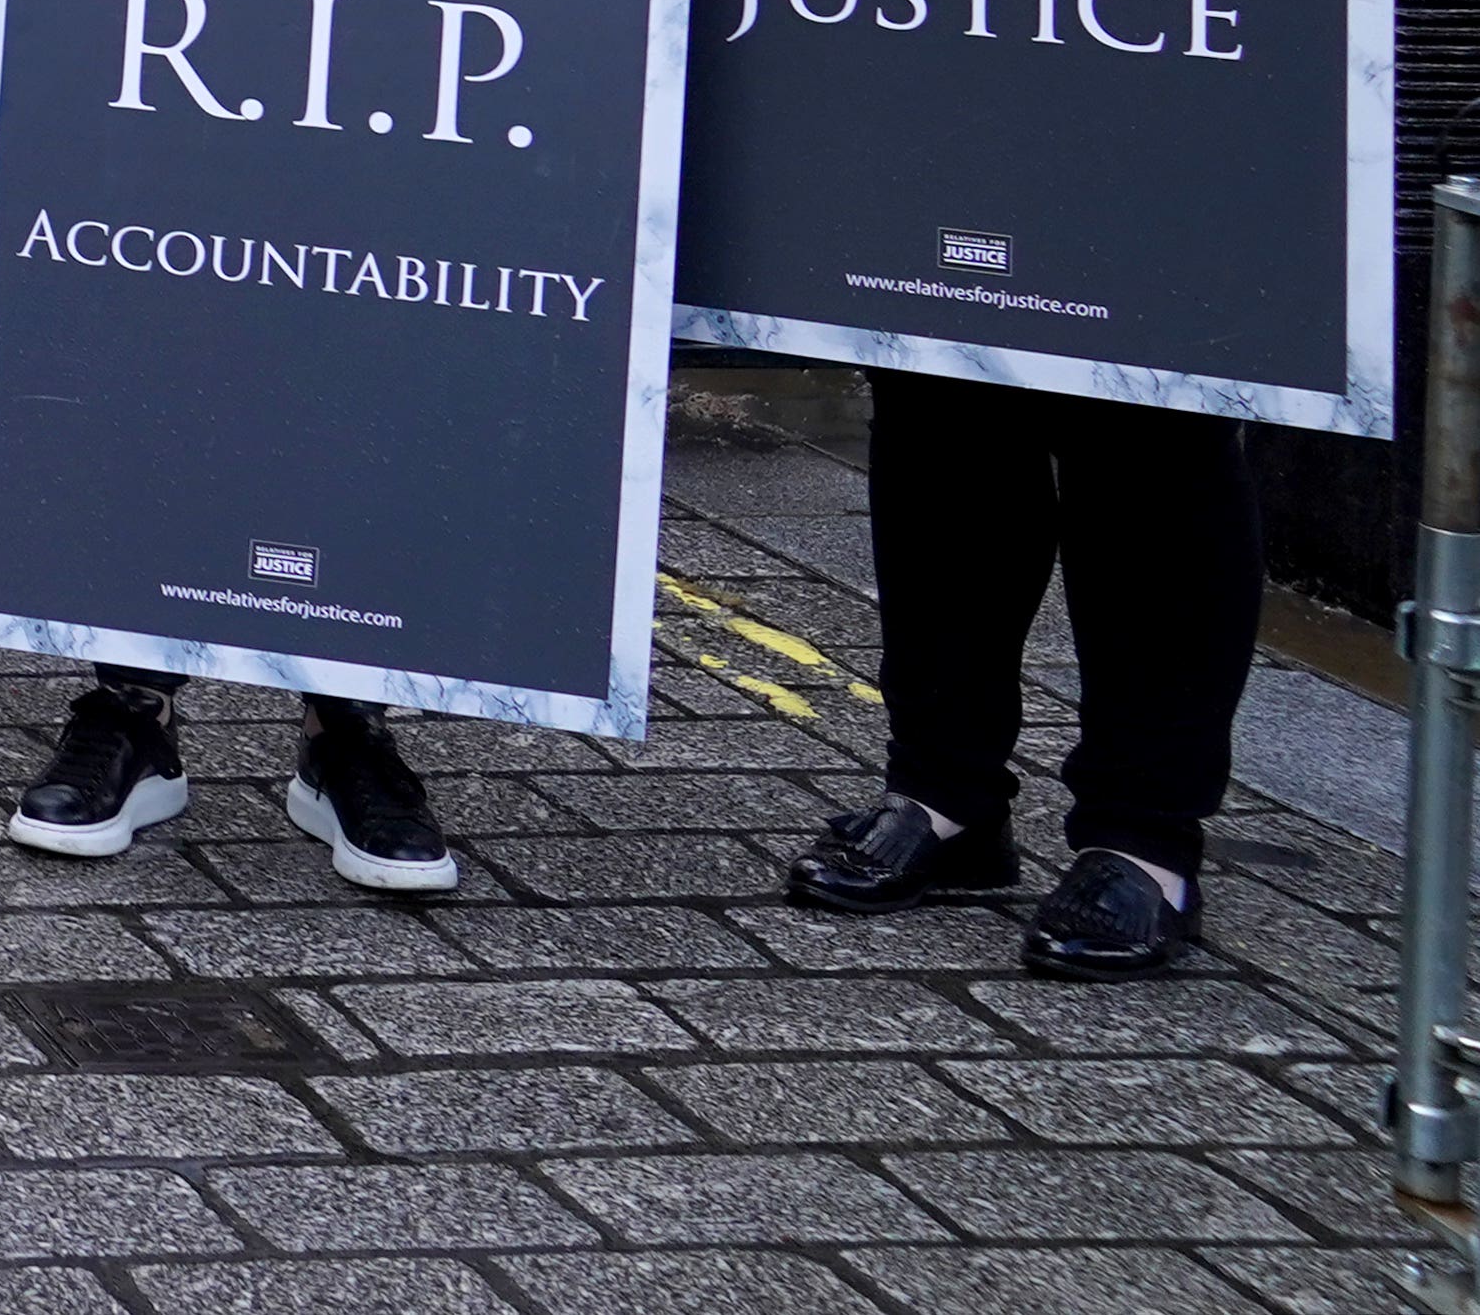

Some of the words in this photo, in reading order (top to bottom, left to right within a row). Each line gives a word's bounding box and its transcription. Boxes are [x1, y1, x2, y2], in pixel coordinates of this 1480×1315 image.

[16, 208, 605, 323] ACCOUNTABILITY
[942, 245, 1007, 264] JUSTICE
[845, 272, 1109, 319] www.relativesforjustice.com
[254, 556, 314, 576] JUSTICE
[160, 583, 403, 629] www.relativesforjustice.com
